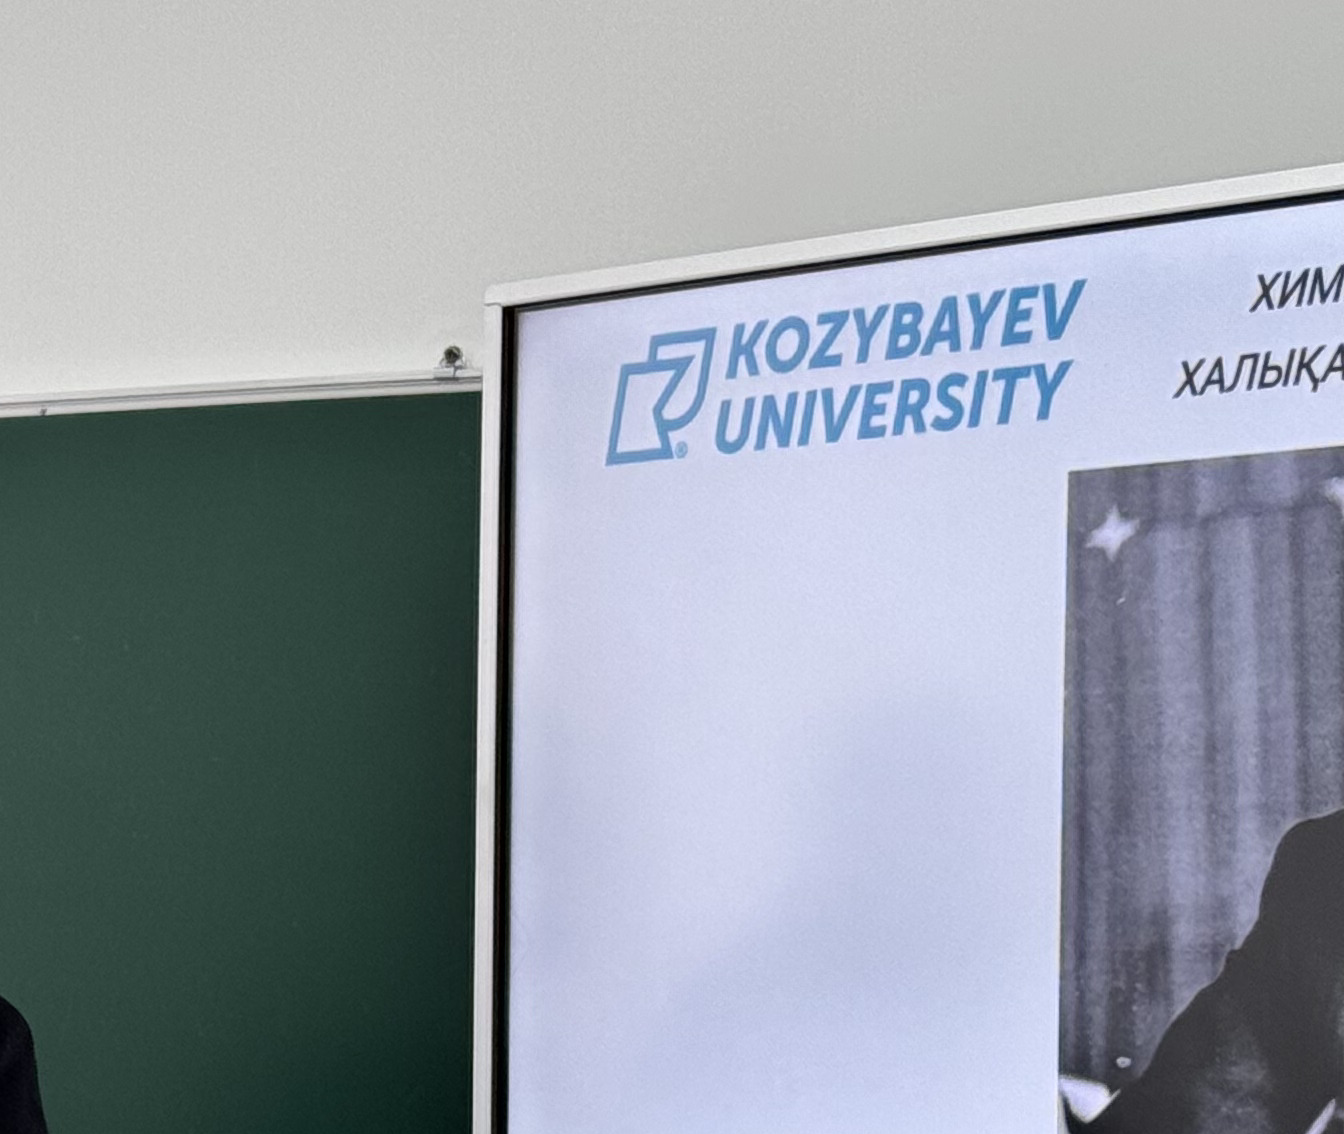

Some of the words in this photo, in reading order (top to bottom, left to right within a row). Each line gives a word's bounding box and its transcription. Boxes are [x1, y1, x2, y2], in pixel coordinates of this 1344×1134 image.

[1248, 264, 1344, 313] ХИМ
[725, 279, 1088, 380] KOZYBAYEV
[715, 359, 1075, 455] UNIVERSITY
[1171, 342, 1344, 399] ХАЛЫҚА
